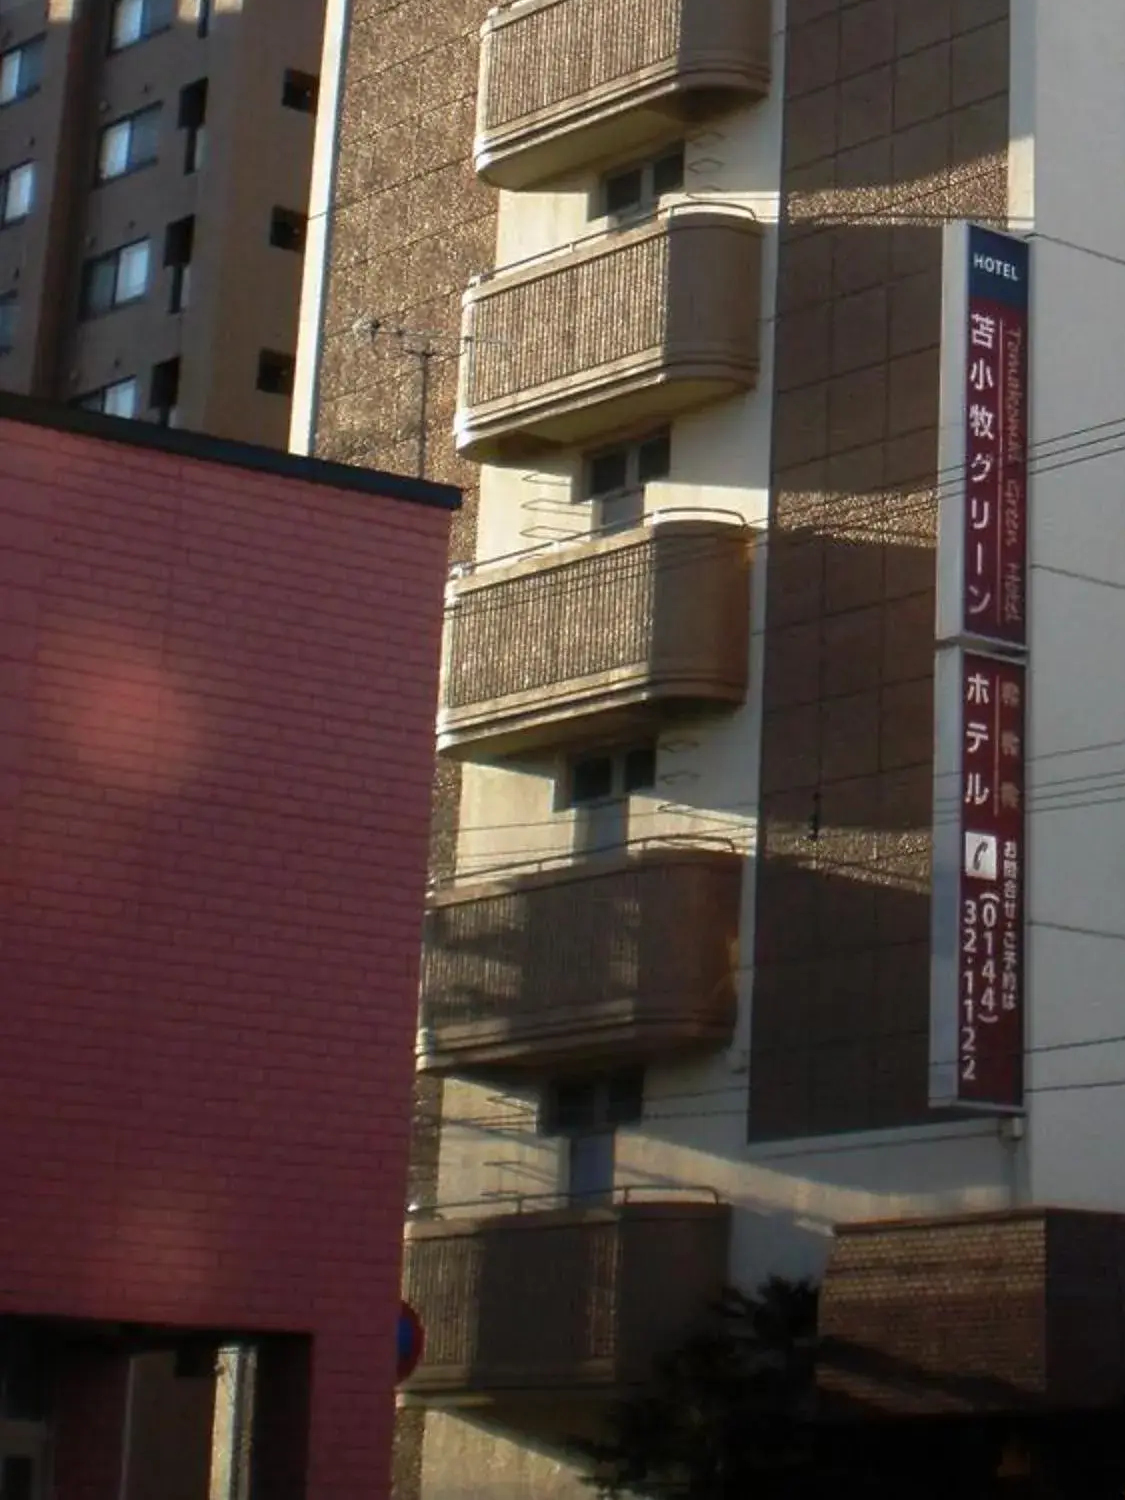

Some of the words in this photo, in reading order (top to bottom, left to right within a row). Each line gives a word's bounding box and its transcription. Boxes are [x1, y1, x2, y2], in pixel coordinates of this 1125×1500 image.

[973, 252, 1019, 282] HOTEL
[968, 312, 995, 615] 苫小牧グリーン
[965, 672, 990, 806] ホテル
[977, 892, 1000, 1023] (0144)
